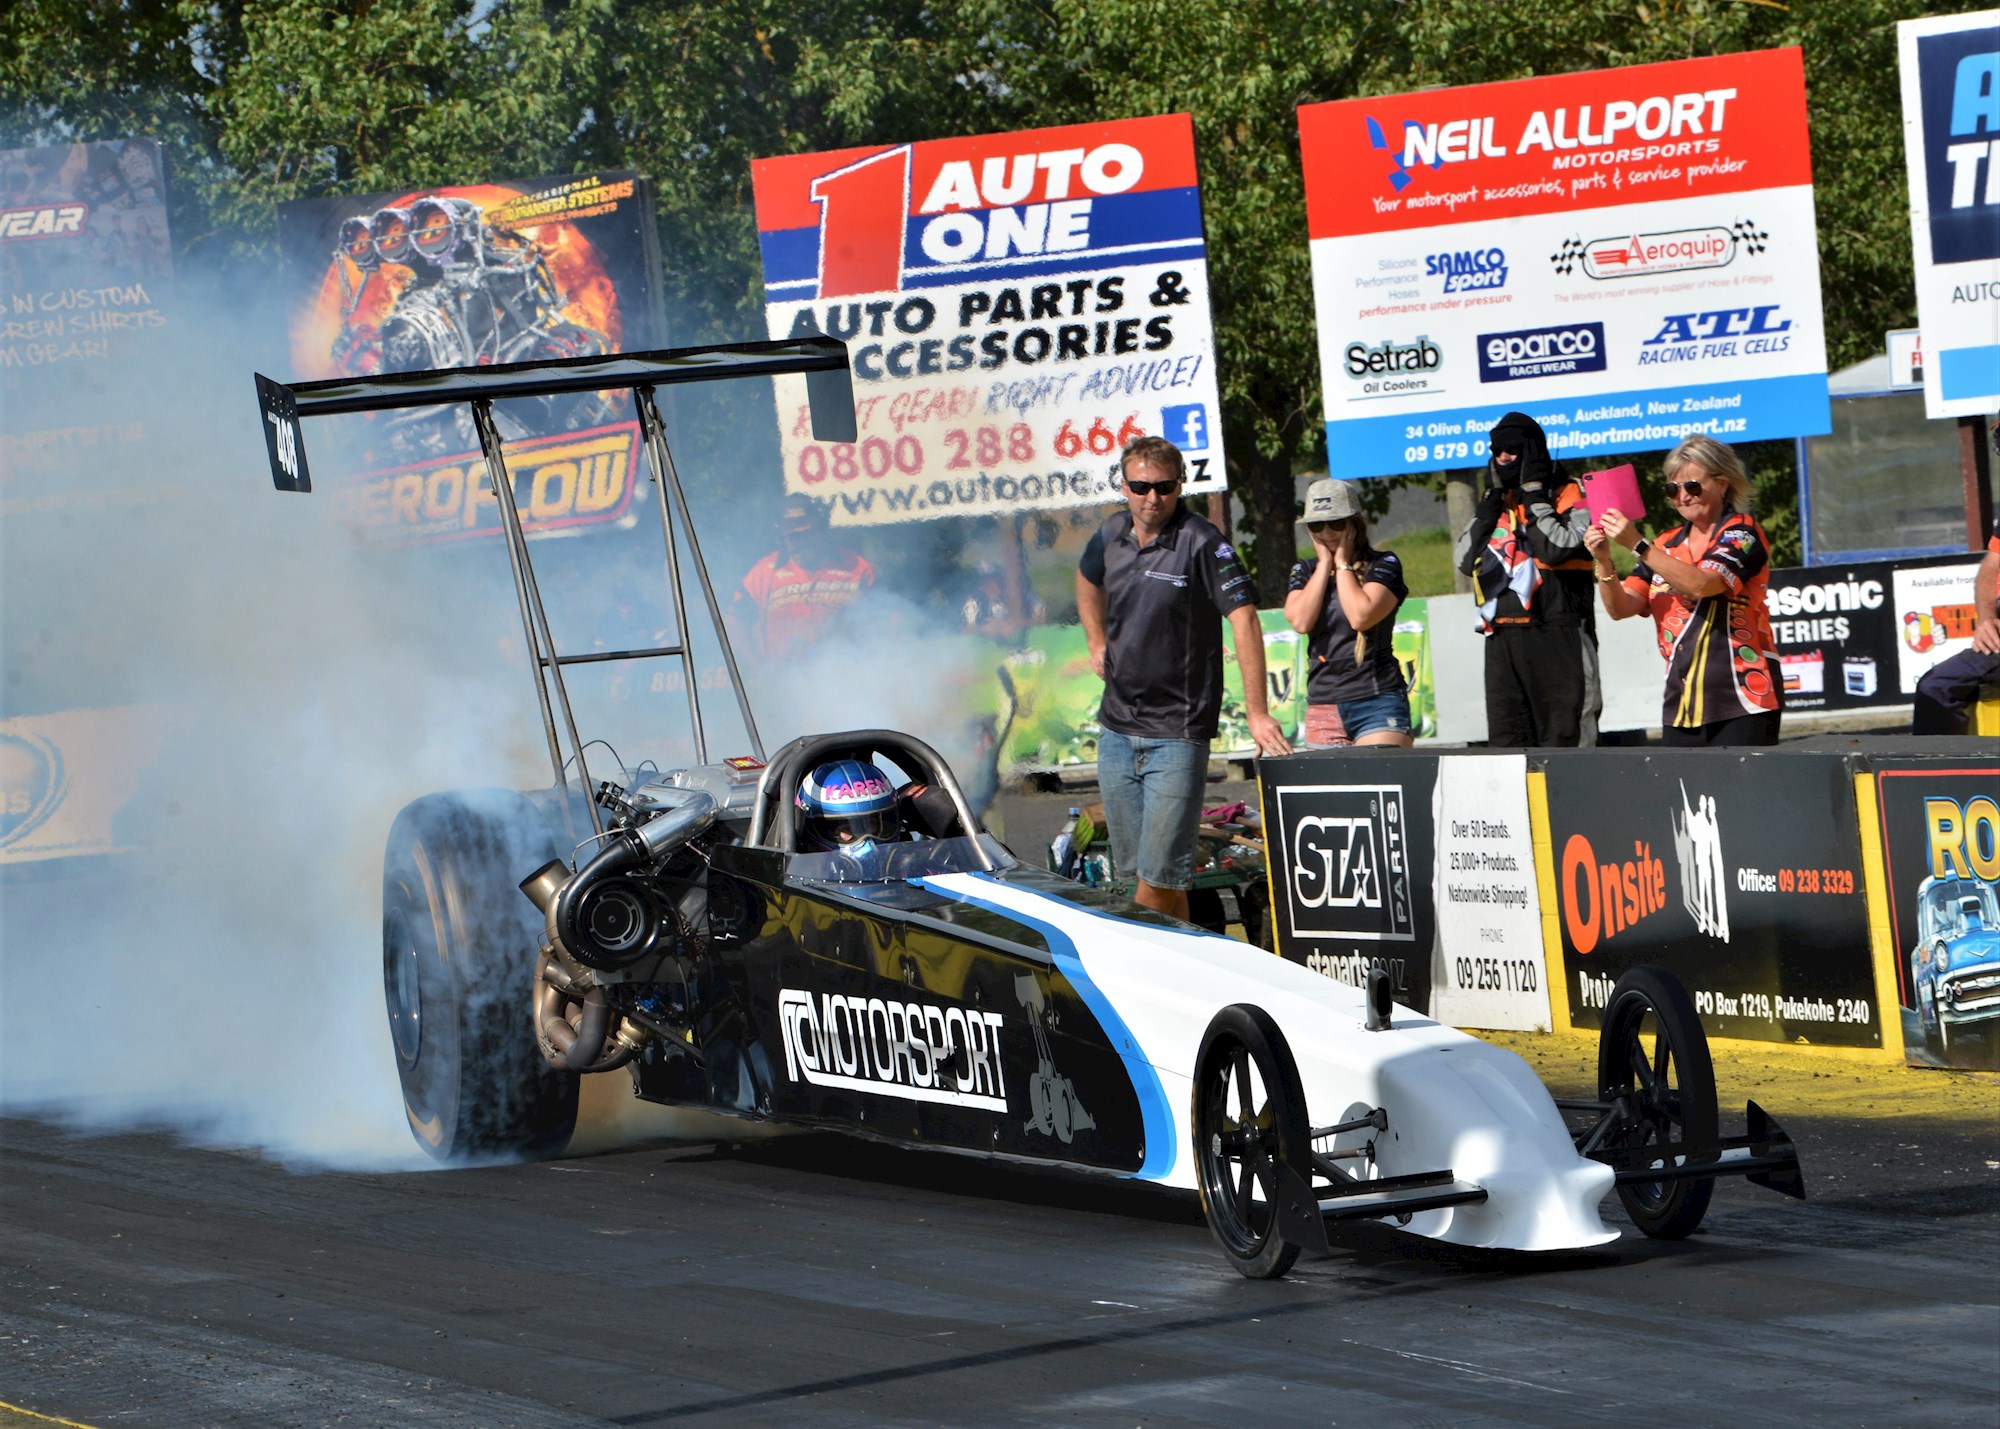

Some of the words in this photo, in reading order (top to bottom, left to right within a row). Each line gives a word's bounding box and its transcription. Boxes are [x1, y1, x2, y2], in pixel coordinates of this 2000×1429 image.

[1404, 117, 1507, 167] NEIL
[1516, 88, 1737, 155] ALLPORT
[1552, 138, 1720, 170] MOTORSPORTS
[568, 179, 634, 209] SYSTEMS
[919, 143, 1145, 213] AUTO
[1373, 196, 1402, 214] Your
[1406, 186, 1479, 212] motorsport
[1484, 178, 1565, 201] accessories,
[1572, 171, 1607, 200] parts
[1629, 164, 1682, 185] service
[1687, 156, 1748, 186] provider
[921, 199, 1093, 265] ONE
[1378, 257, 1418, 271] Silicone
[1426, 248, 1505, 276] SAMCO
[1627, 234, 1727, 265] Aeroquip
[1355, 274, 1419, 289] Performance
[1447, 268, 1503, 292] sport
[1388, 289, 1420, 300] Hoses
[38, 282, 152, 312] CUSTOM
[787, 295, 937, 342] AUTO
[959, 276, 1126, 328] PARTS
[1149, 271, 1192, 307] &
[1359, 303, 1427, 320] performance
[1430, 298, 1462, 312] under
[1464, 293, 1513, 309] pressure
[0, 314, 64, 341] REW
[69, 309, 168, 334] SHIRTS
[1642, 304, 1793, 346] ATL
[853, 314, 1174, 381] CCESSORIES
[1348, 340, 1440, 376] Setrab
[1487, 329, 1596, 366] sparco
[1638, 346, 1698, 366] RACING
[1702, 341, 1738, 359] FUEL
[1744, 336, 1790, 355] CELLS
[1079, 354, 1203, 402] ADVICE!
[1509, 365, 1541, 377] RACE
[1541, 361, 1577, 374] WEAR
[1363, 381, 1380, 393] Oil
[1383, 378, 1428, 392] Coolers
[1405, 425, 1424, 439] 34
[1427, 423, 1462, 437] Olive
[1574, 403, 1644, 424] Auckland,
[1647, 401, 1680, 416] New
[1682, 394, 1742, 413] Zealand
[276, 416, 299, 480] 408
[798, 434, 924, 486] 0800
[943, 421, 1037, 471] 288
[1054, 410, 1147, 459] 666
[1405, 445, 1429, 462] 09
[1433, 442, 1468, 460] 579
[1700, 559, 1737, 588] OFFICIAL
[1911, 577, 1954, 588] Available
[1763, 572, 1884, 617] asonic
[1769, 616, 1851, 644] TERIES
[824, 778, 889, 801] KAREN
[1451, 820, 1470, 839] Over
[1470, 820, 1481, 838] 50
[1482, 819, 1512, 840] Brands.
[1294, 815, 1383, 909] STA
[1386, 800, 1408, 923] PARTS
[1450, 852, 1480, 874] 25,000+
[1481, 851, 1520, 873] Products.
[1447, 882, 1491, 904] Nationwide
[1491, 883, 1529, 909] Shipping!
[1561, 833, 1667, 955] Onsite
[1737, 867, 1778, 892] Office:
[1778, 868, 1796, 893] 09
[1797, 869, 1821, 894] 238
[1822, 869, 1855, 895] 3329
[1480, 928, 1505, 943] PHONE
[1456, 956, 1474, 990] 09
[1475, 957, 1502, 991] 256
[1503, 959, 1538, 993] 1120
[1695, 991, 1715, 1016] PO
[1715, 992, 1740, 1017] Box
[1740, 993, 1774, 1024] 1219,
[1774, 994, 1836, 1023] Pukekohe
[1837, 998, 1870, 1025] 2340
